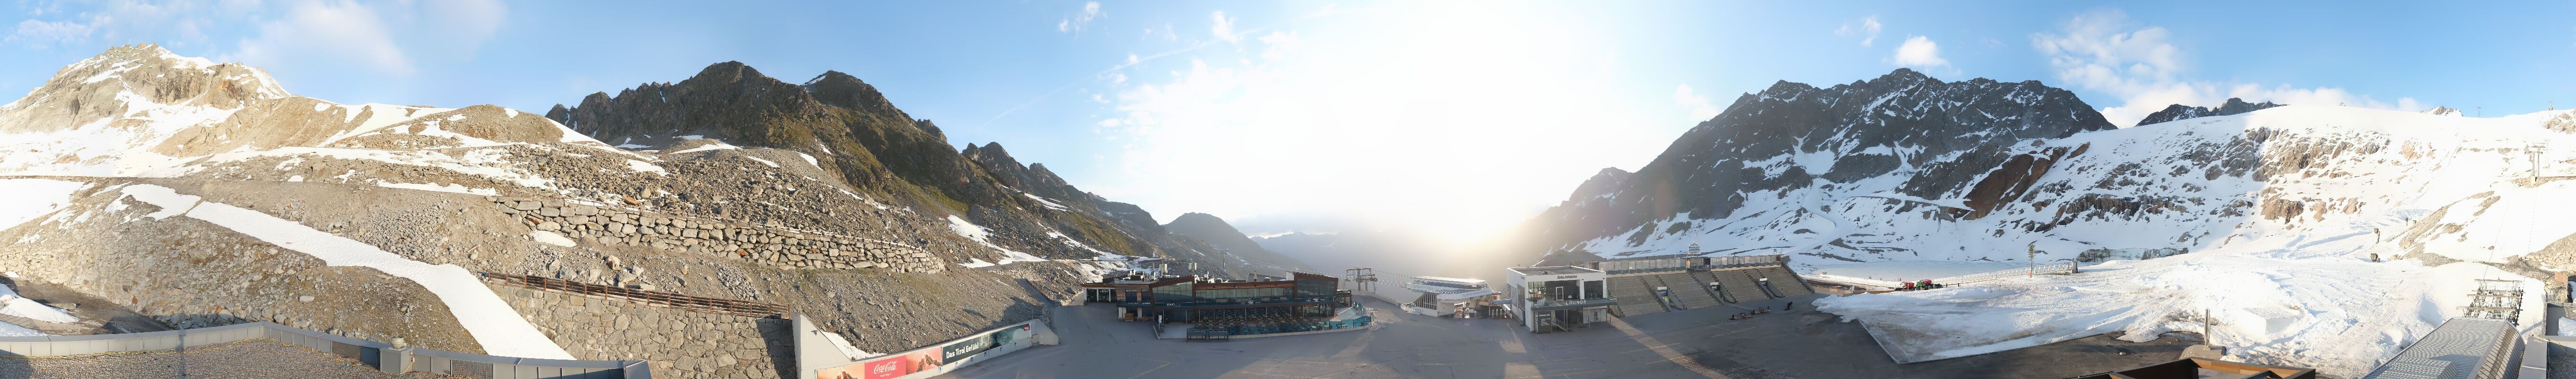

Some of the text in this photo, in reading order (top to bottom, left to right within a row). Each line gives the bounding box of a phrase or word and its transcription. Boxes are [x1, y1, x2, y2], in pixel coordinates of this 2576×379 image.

[956, 347, 965, 355] Tirol
[966, 343, 979, 352] Gefühl
[874, 361, 897, 374] Coca-Cola
